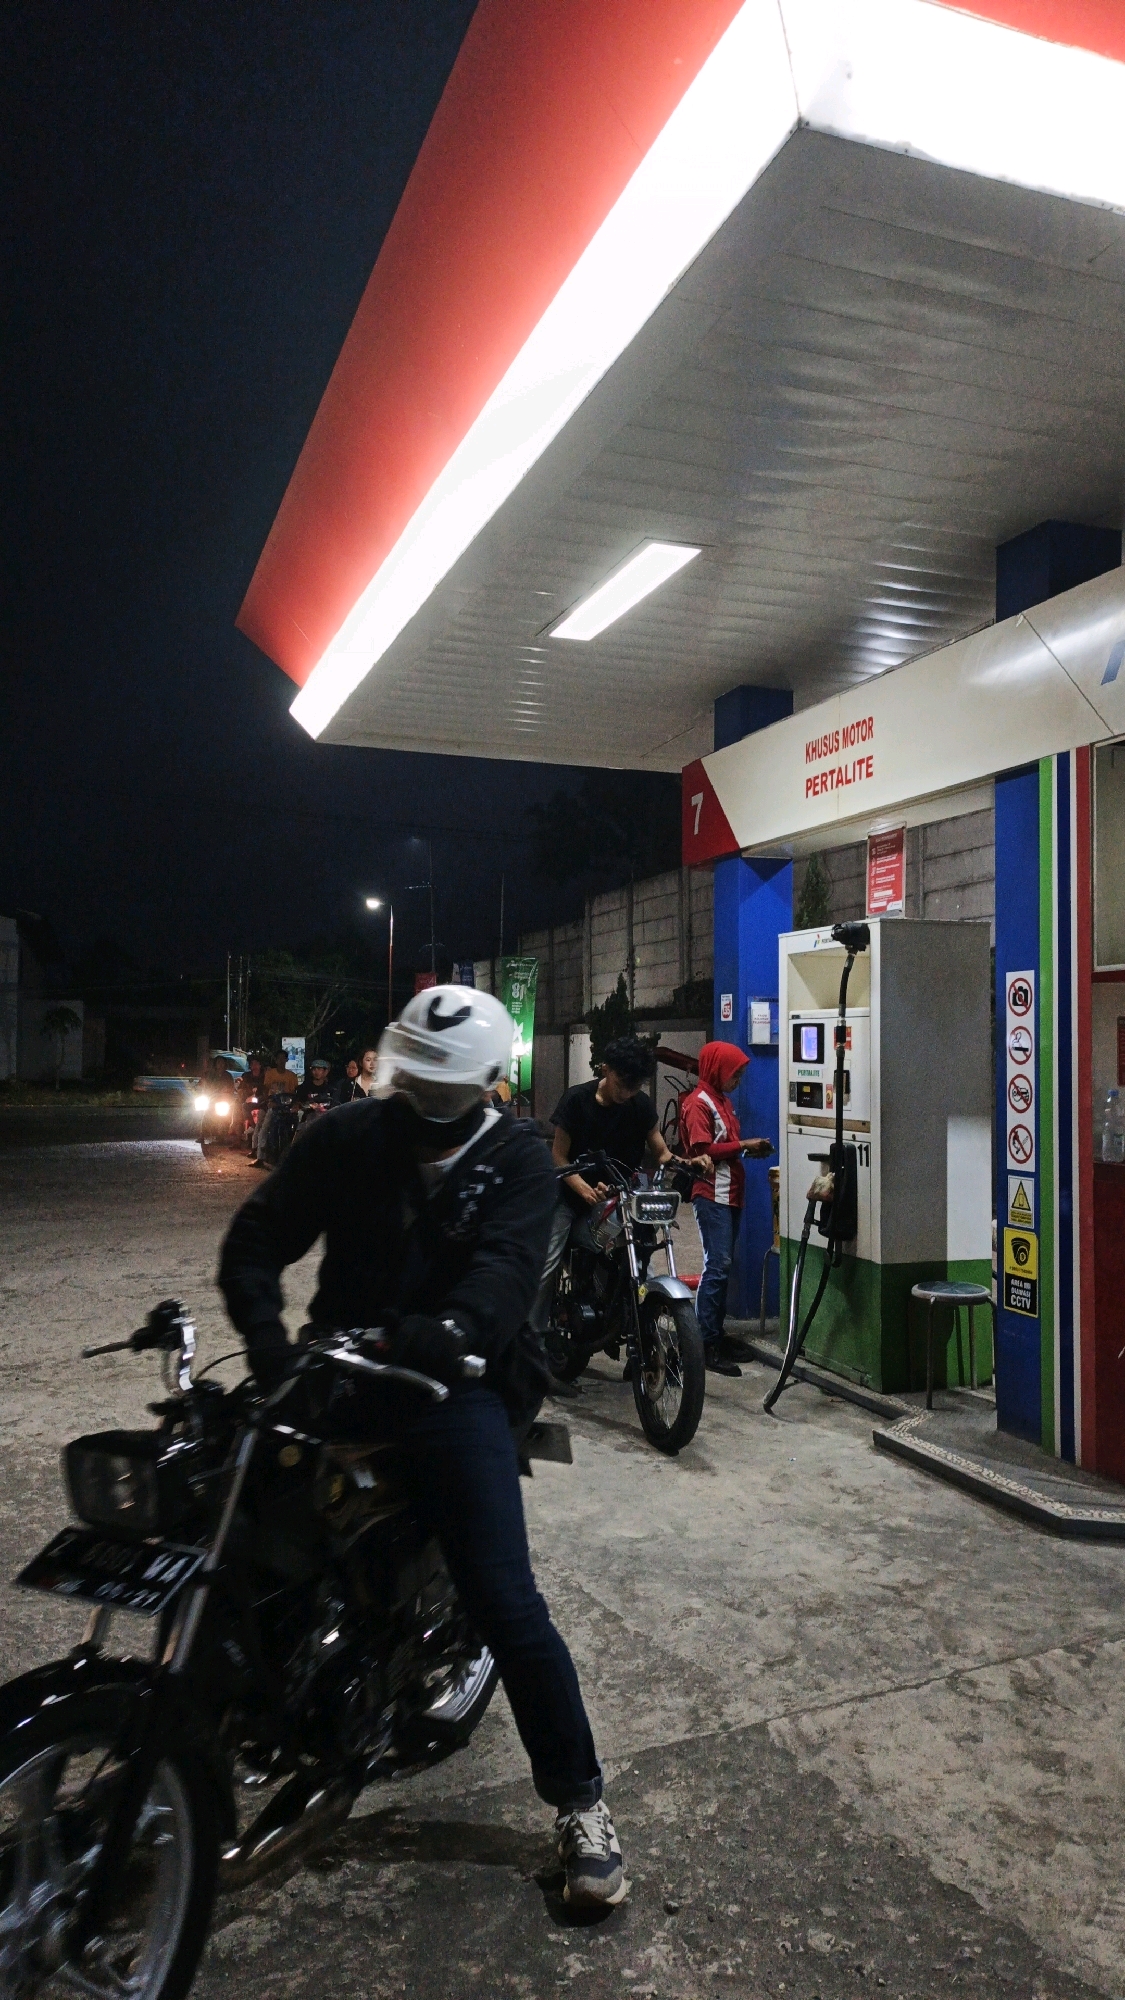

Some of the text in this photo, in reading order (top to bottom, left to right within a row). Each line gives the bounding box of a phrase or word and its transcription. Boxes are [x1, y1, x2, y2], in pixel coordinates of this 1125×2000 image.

[805, 716, 874, 765] KHUSUS MOTOR
[805, 754, 874, 799] PERTALITE
[691, 792, 704, 836] 7
[797, 1069, 820, 1077] PERTALITE
[857, 1143, 870, 1168] 11
[1010, 1278, 1023, 1288] AREA
[1010, 1294, 1031, 1310] CCTV
